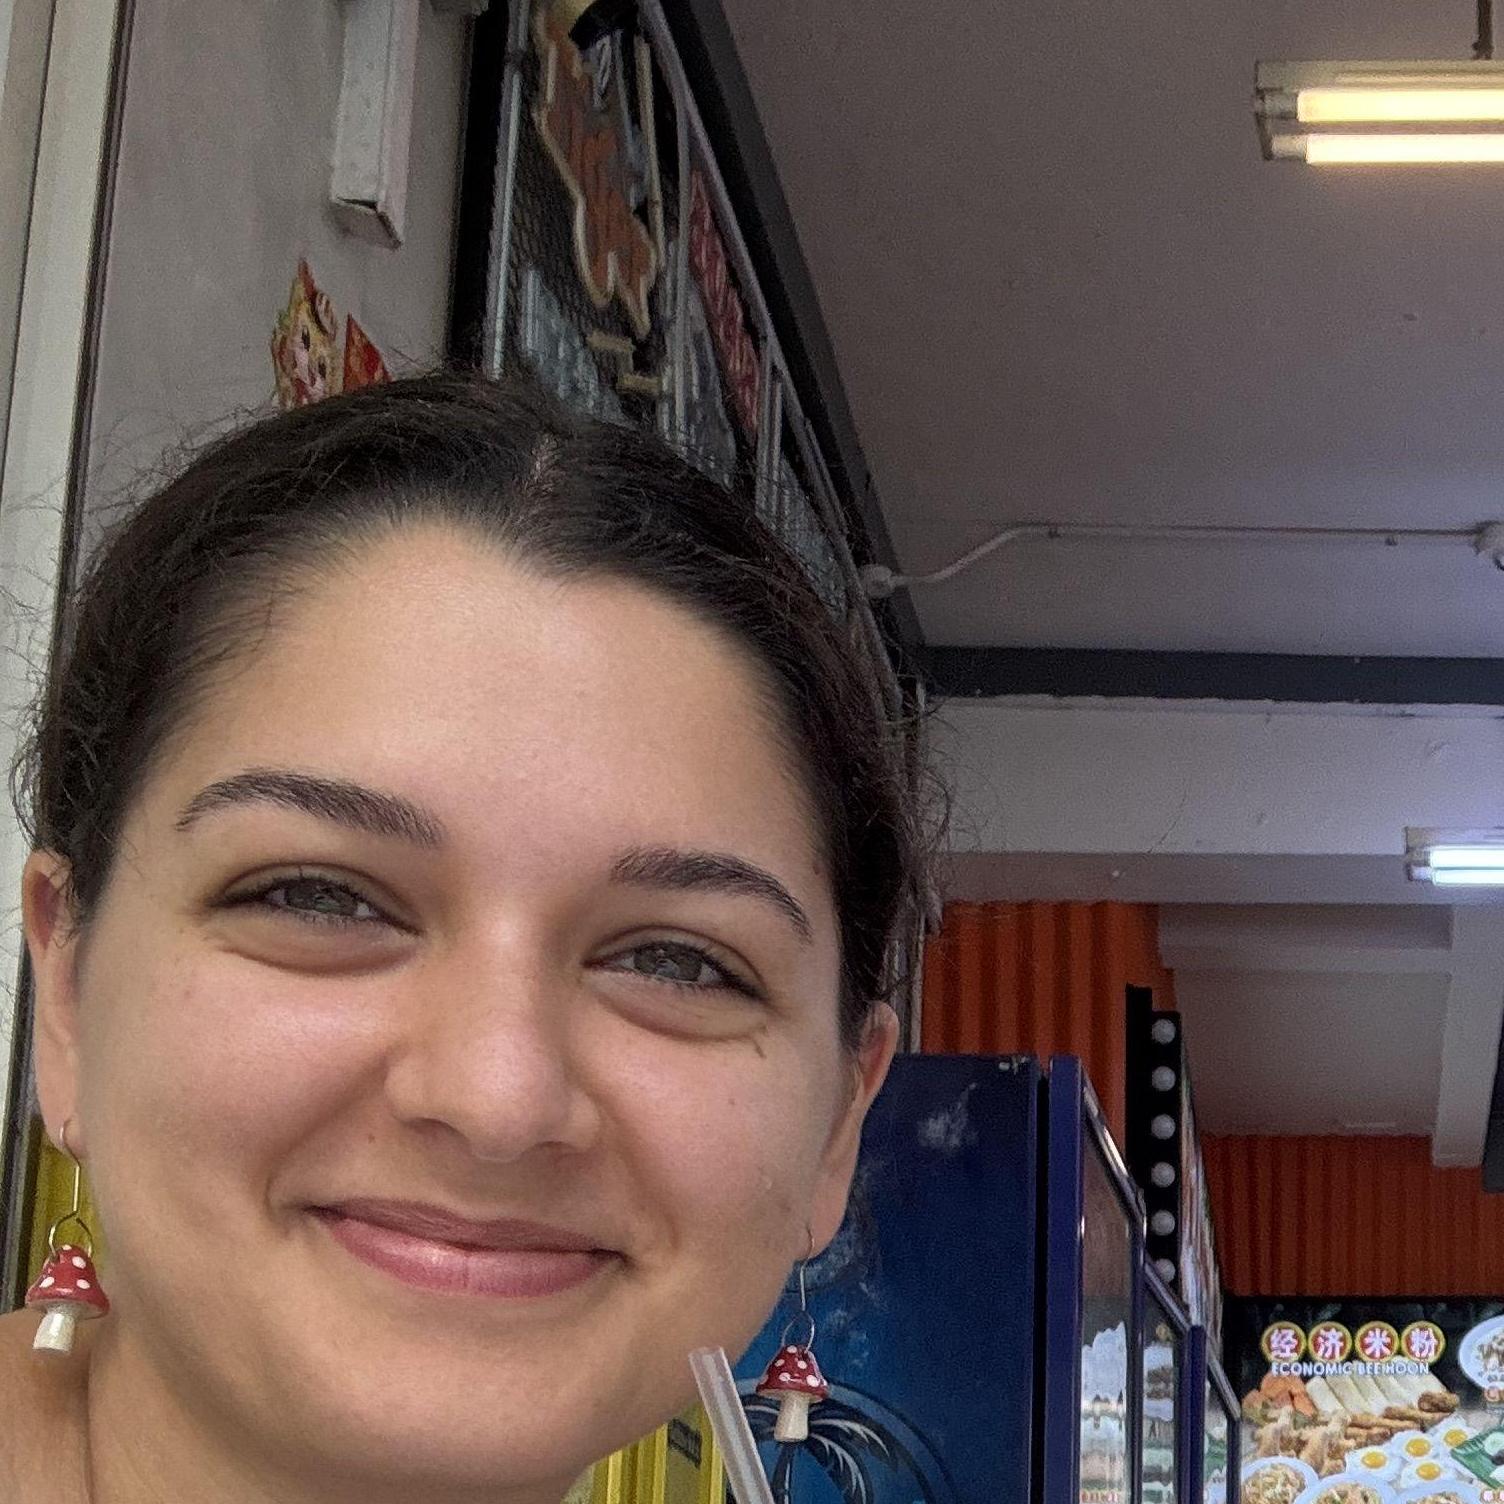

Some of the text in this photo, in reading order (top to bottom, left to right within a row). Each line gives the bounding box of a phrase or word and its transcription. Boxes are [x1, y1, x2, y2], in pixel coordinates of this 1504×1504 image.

[1269, 1327, 1439, 1359] 经济米粉
[1271, 1362, 1429, 1376] ECONOMIC BEE HOON
